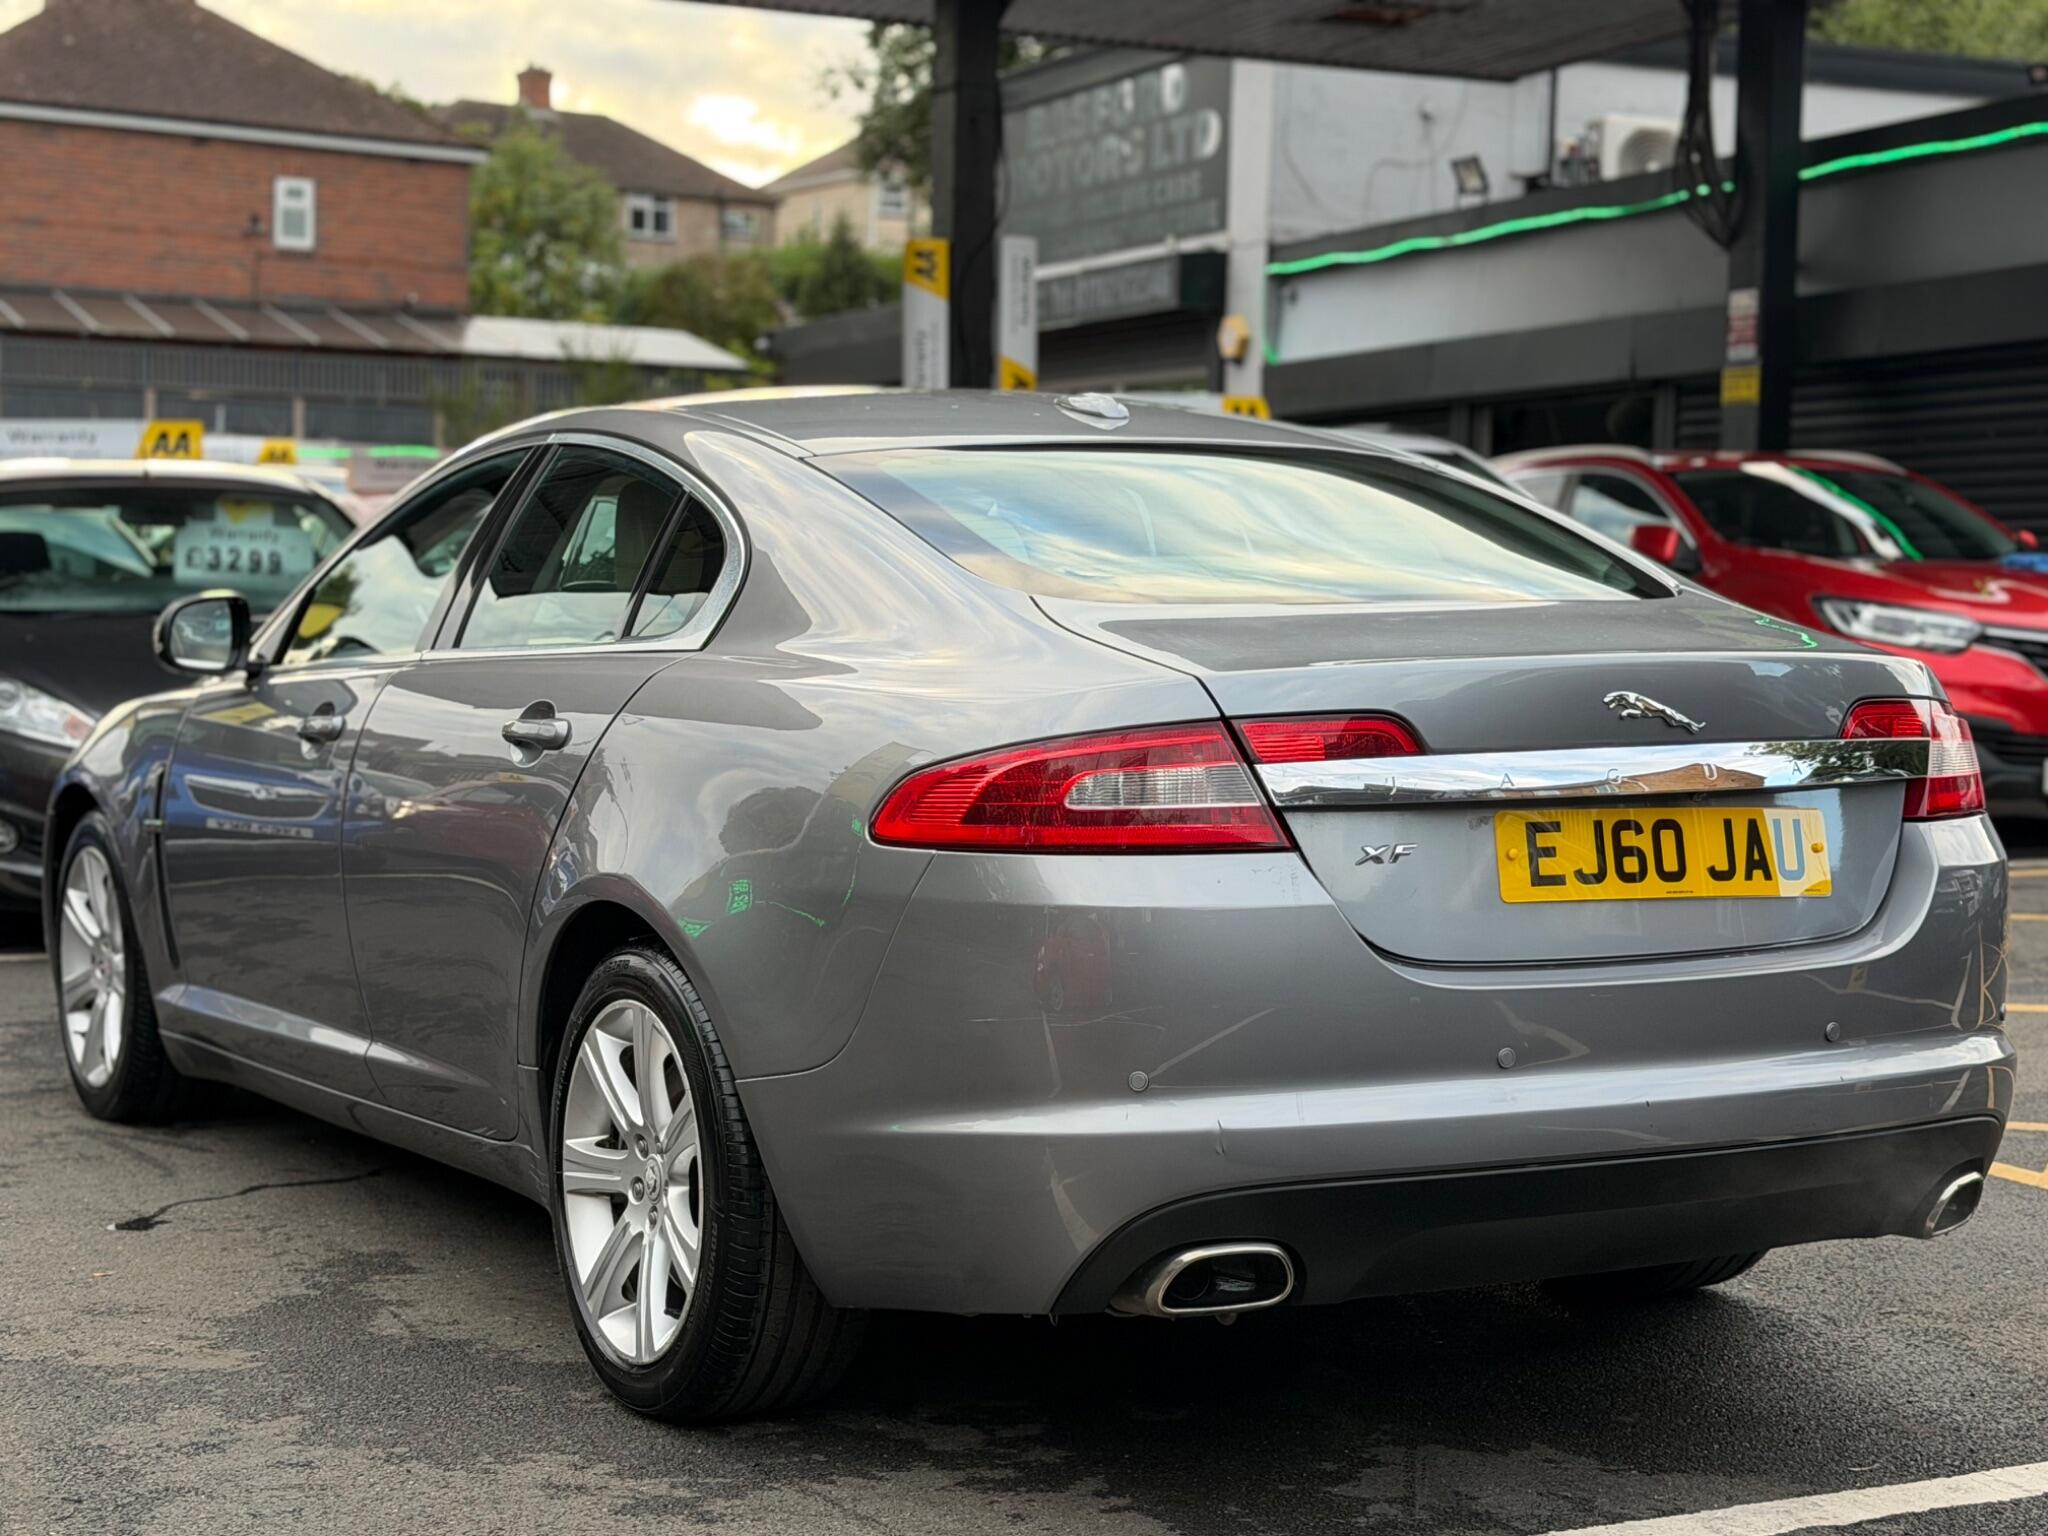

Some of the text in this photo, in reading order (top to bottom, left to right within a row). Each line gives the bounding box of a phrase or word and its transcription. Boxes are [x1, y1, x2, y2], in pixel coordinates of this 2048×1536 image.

[1152, 108, 1222, 171] LTD
[152, 431, 191, 456] AA
[1355, 843, 1418, 866] XF
[1524, 818, 1806, 887] EJ60 JAU
